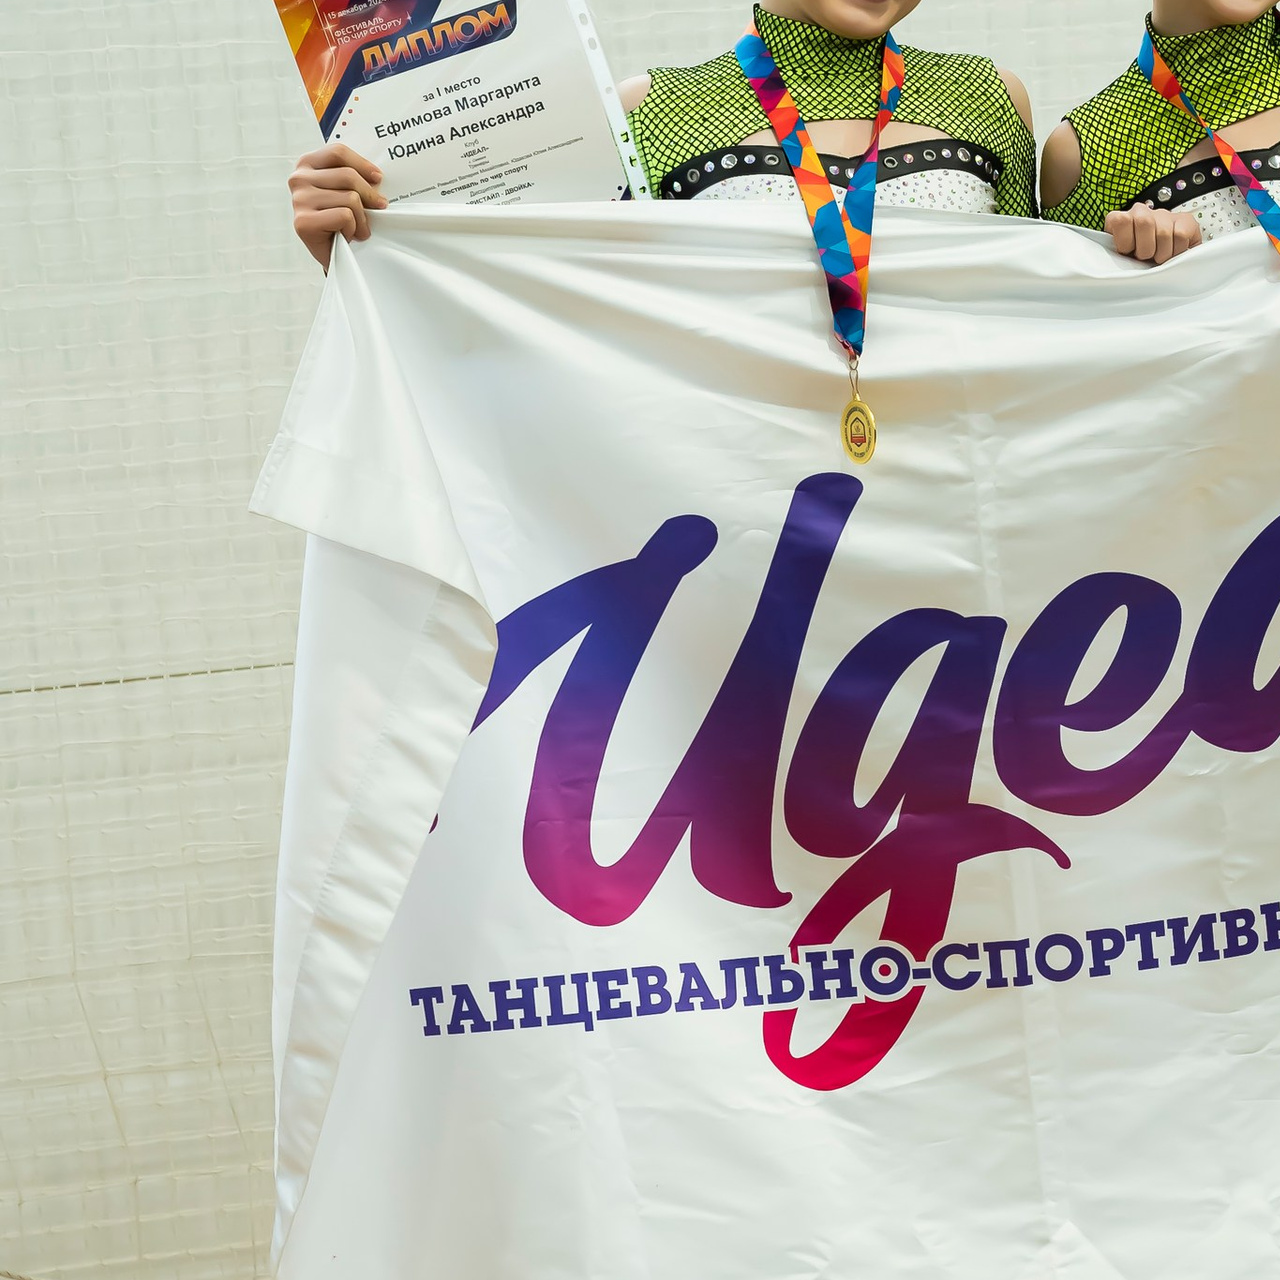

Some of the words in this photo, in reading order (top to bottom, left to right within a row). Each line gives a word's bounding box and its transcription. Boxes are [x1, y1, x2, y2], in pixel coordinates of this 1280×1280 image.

[334, 16, 385, 38] ФЕСТИВАЛЬ
[337, 34, 352, 46] ПО
[351, 28, 371, 43] ЧИР
[370, 18, 403, 36] СПОРТУ
[361, 3, 514, 82] ДИПЛОМ
[421, 92, 435, 103] за
[443, 75, 482, 95] место
[374, 105, 453, 140] Ефимова
[453, 74, 542, 113] Маргарита
[388, 130, 446, 161] Юдина
[449, 100, 546, 141] Александра
[440, 181, 479, 197] Фестиваль
[490, 172, 504, 181] чир
[504, 164, 529, 176] спорту
